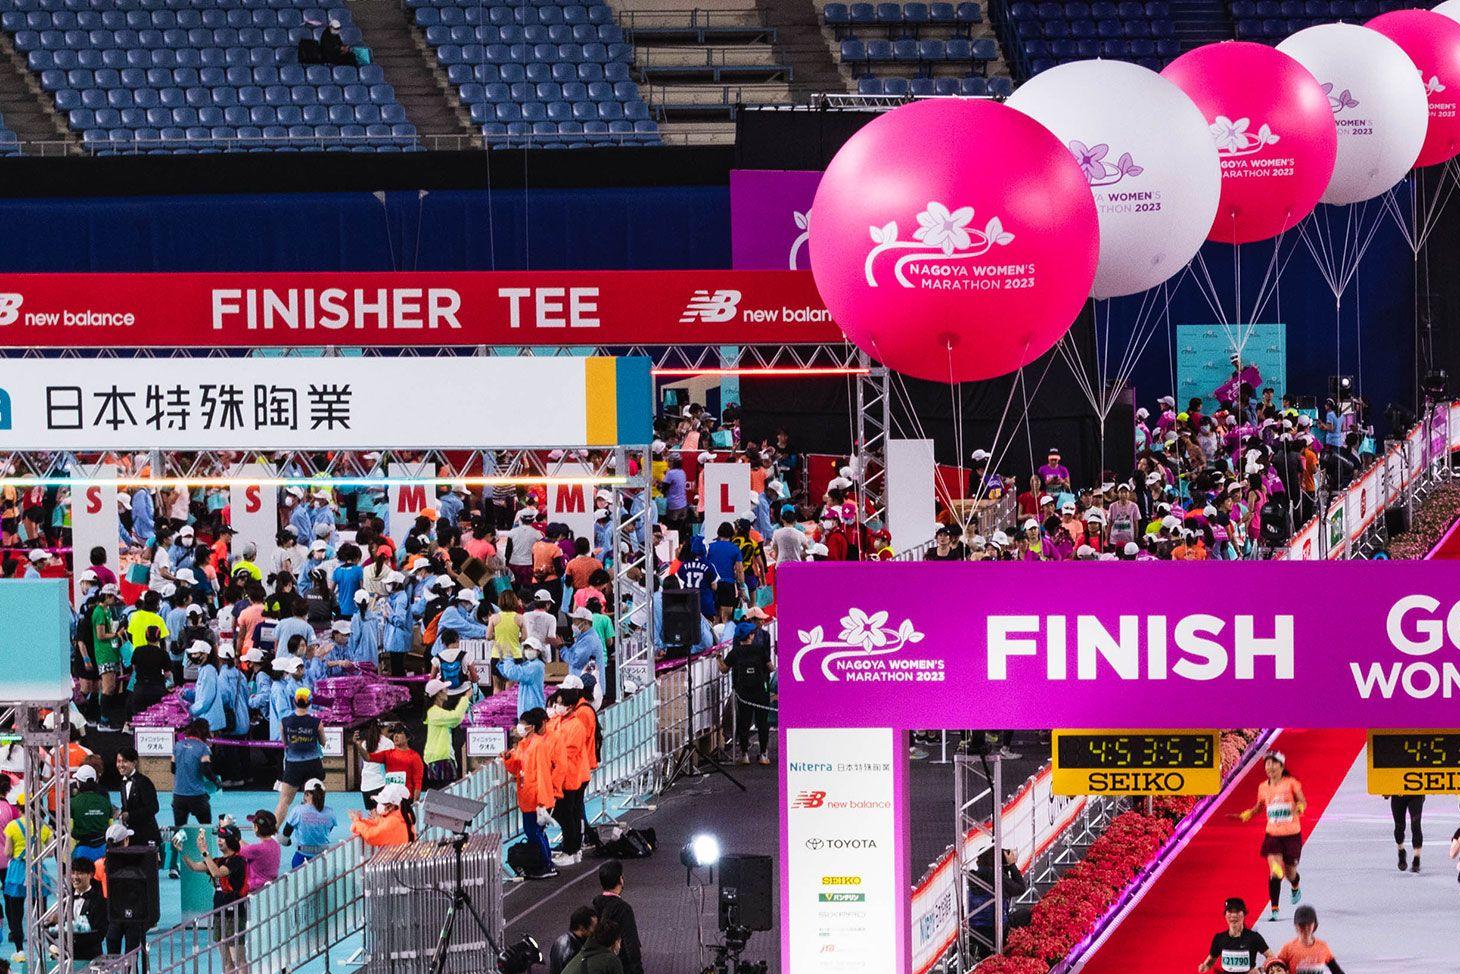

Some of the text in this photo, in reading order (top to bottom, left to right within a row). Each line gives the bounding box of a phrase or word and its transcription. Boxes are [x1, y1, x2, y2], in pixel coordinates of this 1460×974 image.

[1352, 128, 1373, 136] 2023
[1220, 158, 1295, 169] GOYA WOMEN'S
[1221, 168, 1294, 179] ARATHON 2023
[1135, 203, 1162, 212] 2023
[909, 263, 1035, 277] NAGOYA WOMEN'S
[921, 277, 1035, 289] MARATHON 2023
[212, 287, 600, 330] FINISHER TEE
[743, 310, 778, 322] new
[781, 306, 833, 322] balan
[25, 309, 135, 327] new balance
[45, 384, 352, 431] 日本特殊陶業
[86, 485, 102, 513] S
[246, 485, 261, 512] S
[397, 485, 426, 512] M
[555, 484, 585, 513] M
[720, 484, 735, 512] L
[686, 572, 704, 588] 17
[987, 615, 1294, 680] FINISH
[837, 660, 944, 671] NAGOYA WOMEN'S
[846, 672, 945, 682] MARATHON 2023
[790, 761, 890, 772] Niterra 日本特殊陶業
[1088, 773, 1184, 792] SEIKO
[850, 800, 891, 809] balance
[827, 839, 877, 849] TOYOTA
[822, 876, 861, 885] SEIKO
